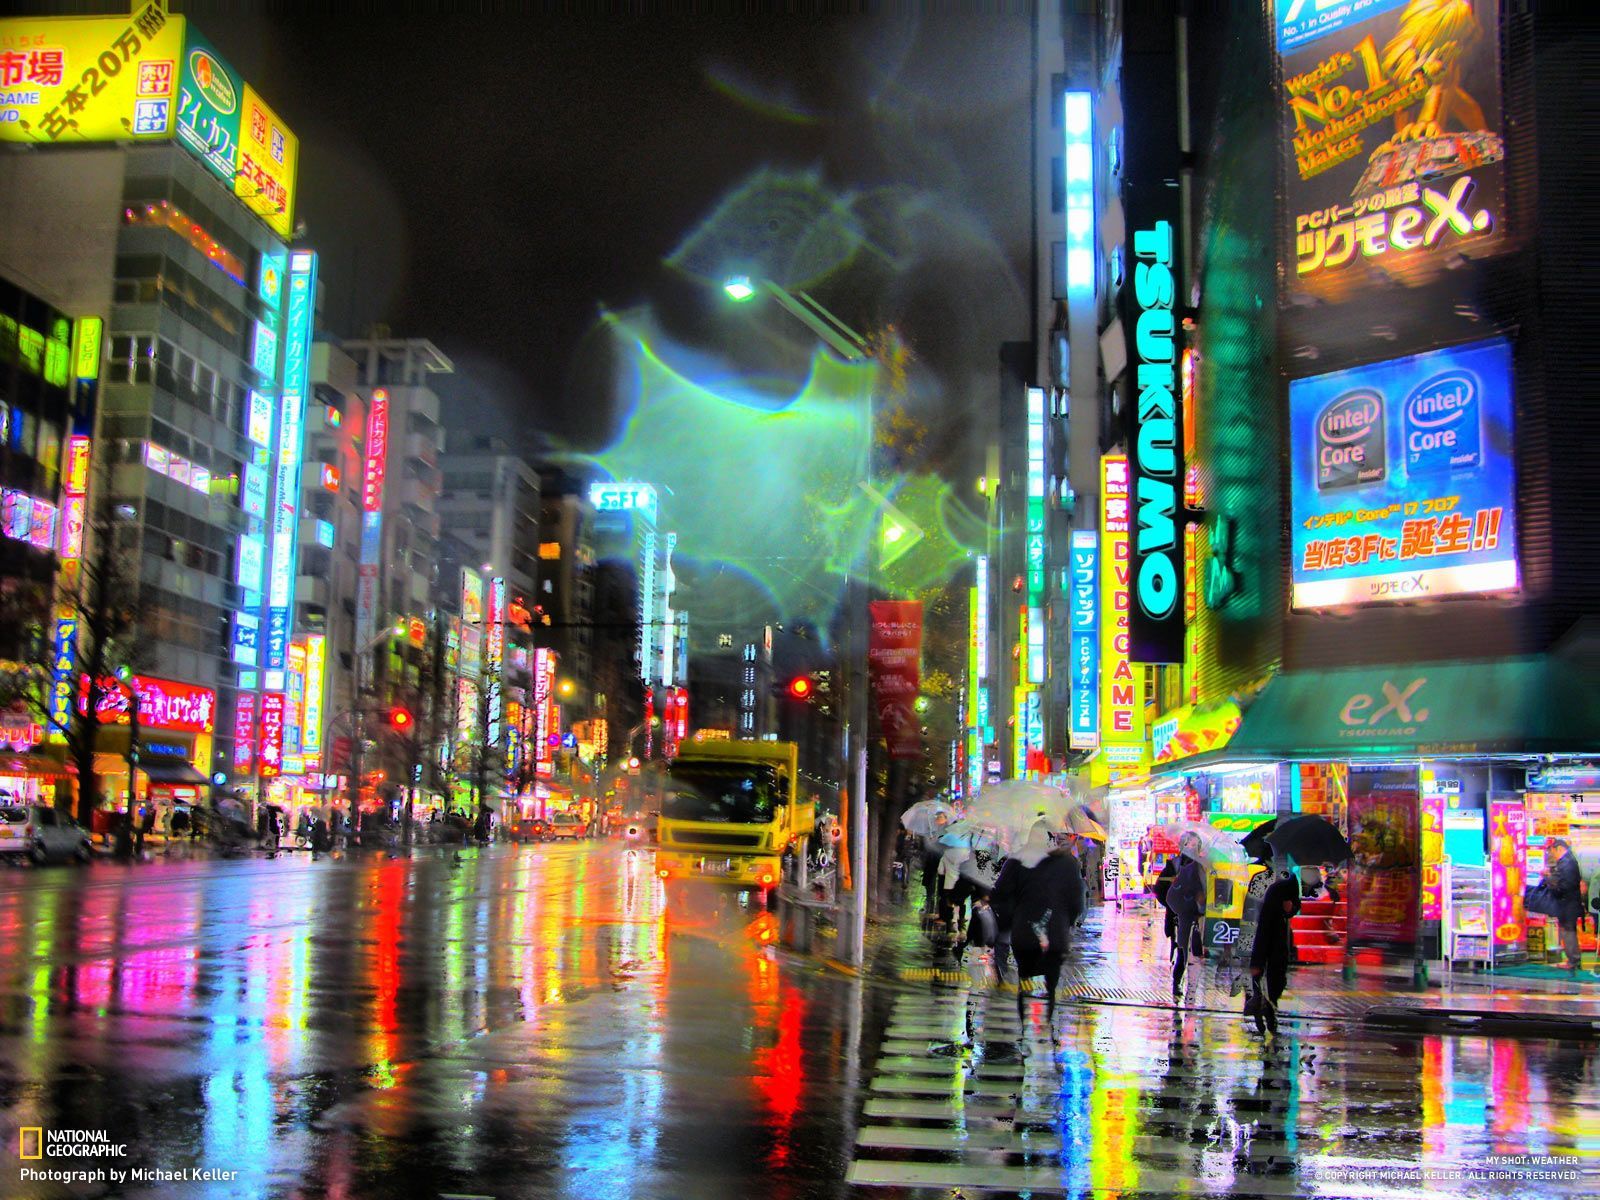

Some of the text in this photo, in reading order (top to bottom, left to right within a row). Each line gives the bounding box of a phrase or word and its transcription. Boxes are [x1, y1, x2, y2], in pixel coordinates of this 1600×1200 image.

[1319, 5, 1352, 25] Quality
[1285, 52, 1353, 94] World's
[1292, 72, 1427, 153] Motherboard
[1296, 134, 1360, 178] Maker
[1417, 386, 1463, 415] intel
[1134, 220, 1176, 619] TSUKUMO
[1327, 404, 1370, 431] intel
[1409, 430, 1456, 451] Core
[1321, 445, 1365, 467] Core
[1075, 553, 1095, 626] ソフマップ
[1338, 727, 1417, 737] TSUKUMO
[1213, 921, 1240, 943] 2F
